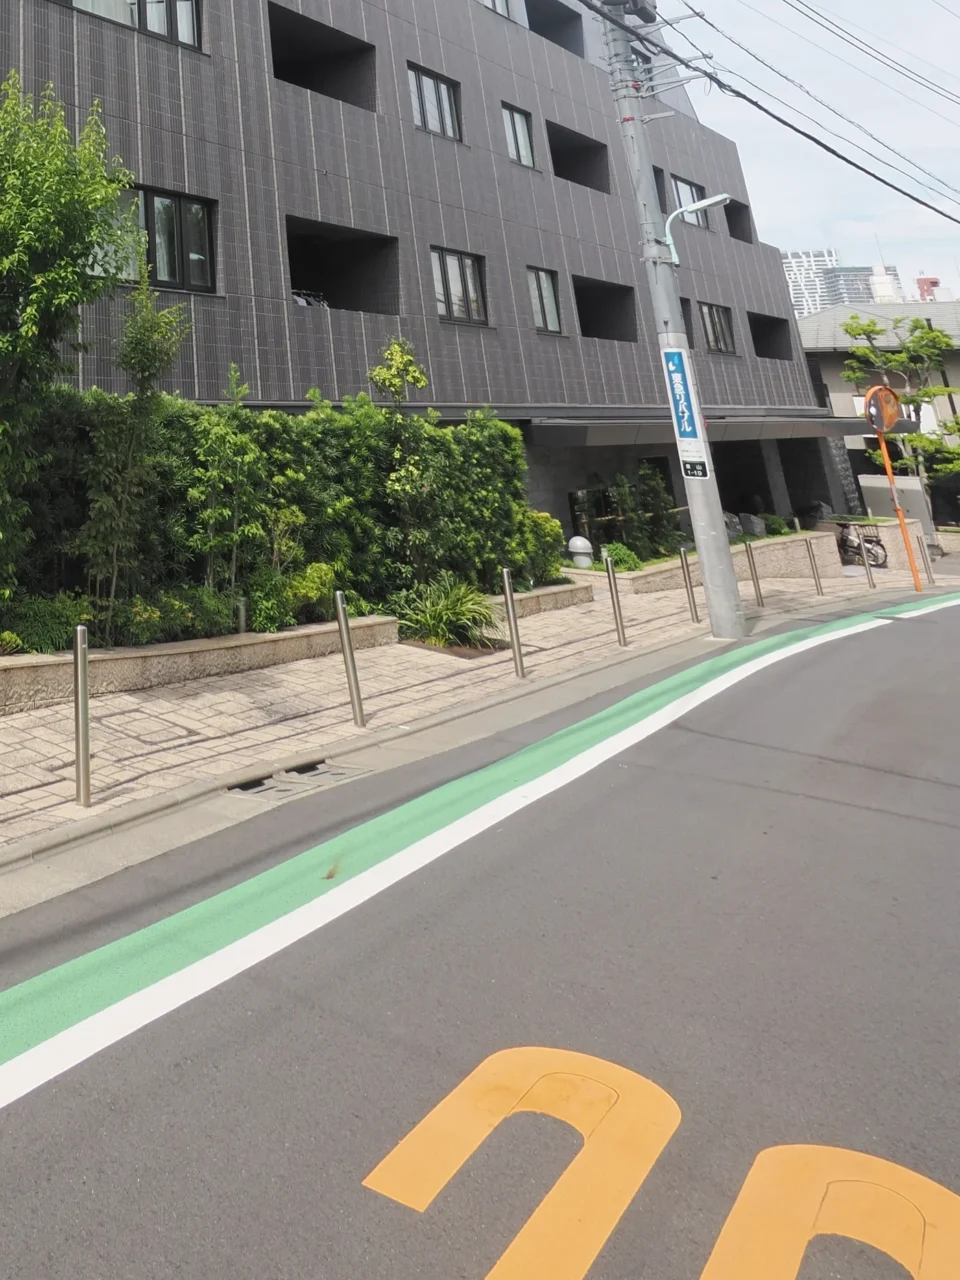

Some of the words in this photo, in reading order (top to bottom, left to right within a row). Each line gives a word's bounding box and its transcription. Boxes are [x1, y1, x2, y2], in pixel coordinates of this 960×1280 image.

[671, 372, 692, 432] 東急リバブル
